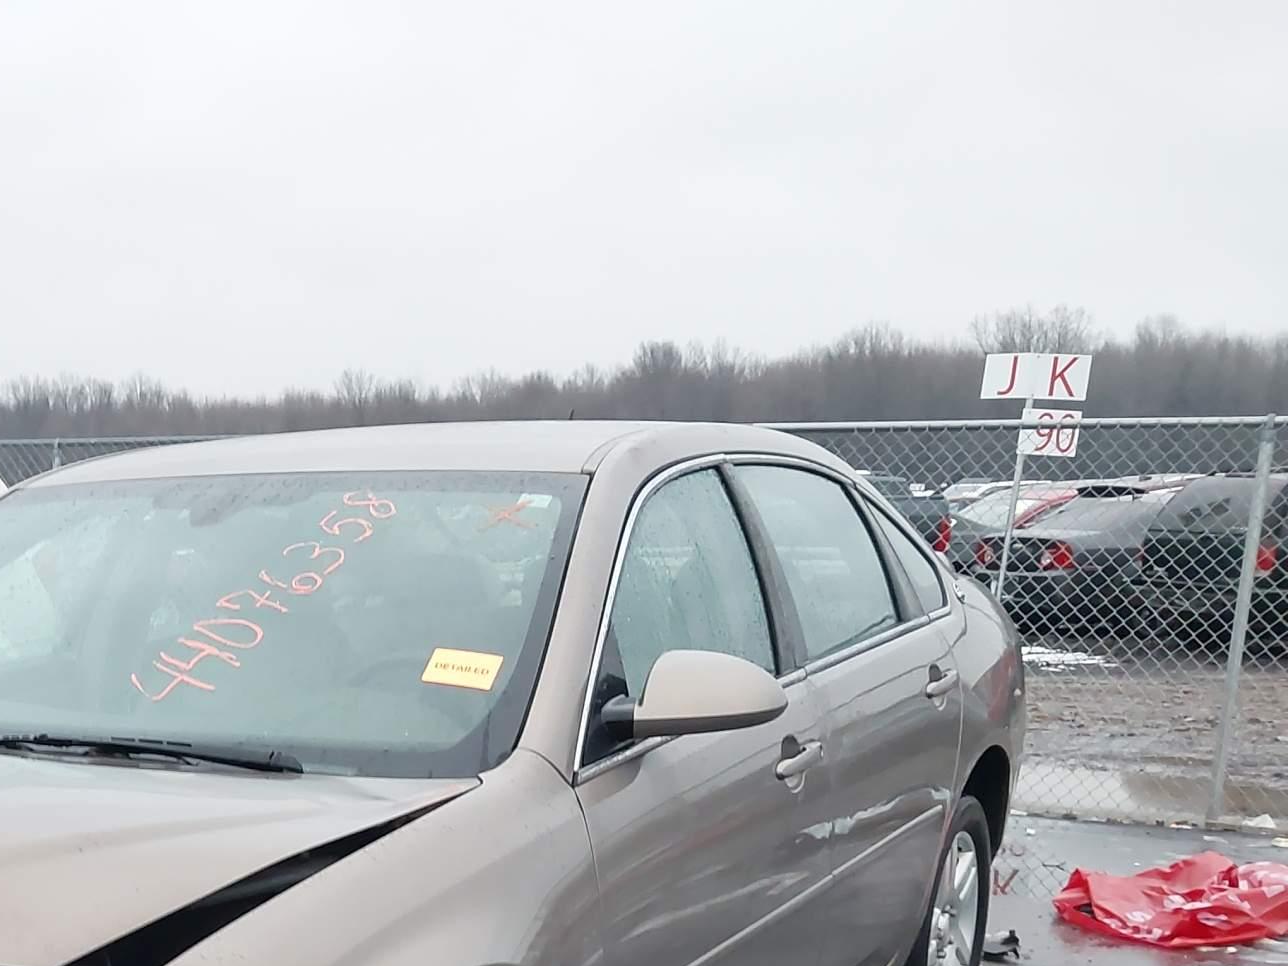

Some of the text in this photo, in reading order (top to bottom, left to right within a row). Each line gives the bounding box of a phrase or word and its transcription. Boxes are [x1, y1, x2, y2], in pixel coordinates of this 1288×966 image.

[996, 355, 1080, 398] J K
[1034, 412, 1076, 454] 90
[131, 488, 397, 701] 44076358
